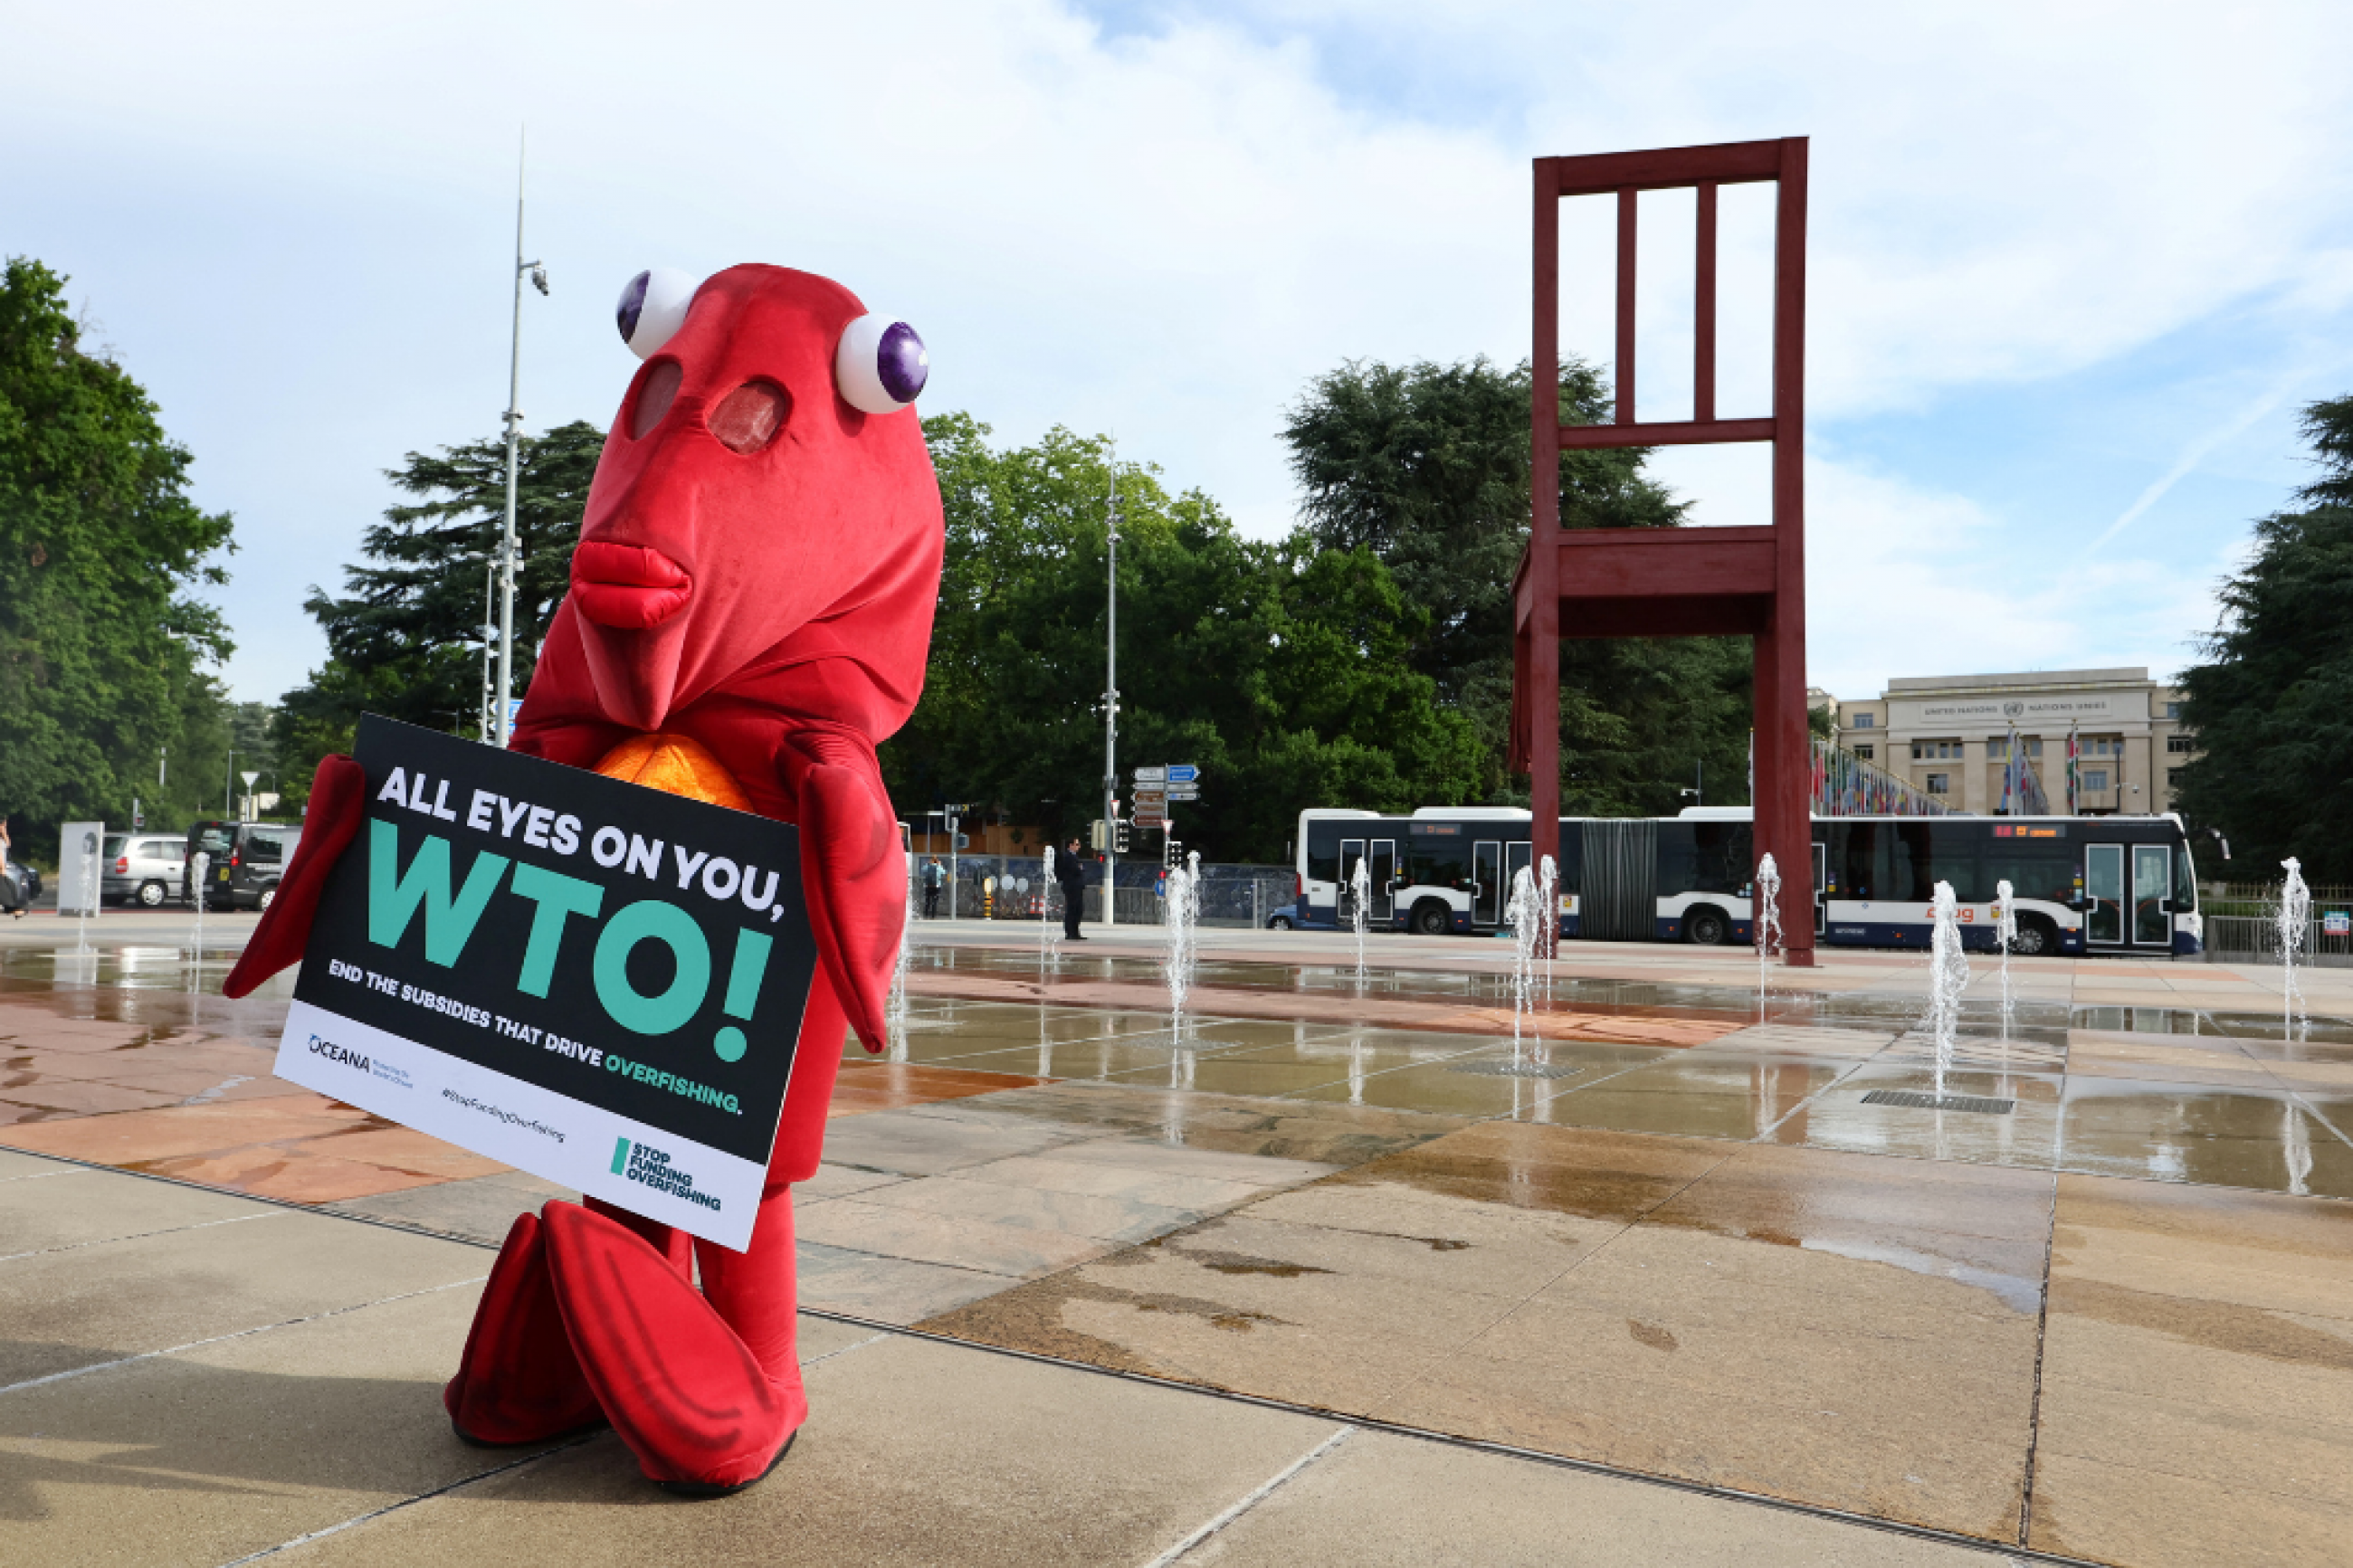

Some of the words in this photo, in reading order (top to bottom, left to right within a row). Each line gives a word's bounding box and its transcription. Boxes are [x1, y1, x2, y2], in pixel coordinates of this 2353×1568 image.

[1958, 705, 1997, 714] NATIONS
[2028, 701, 2073, 711] NATIONS
[377, 766, 456, 822] ALL
[466, 789, 583, 856] EYES
[591, 825, 663, 880] ON
[673, 844, 785, 922] YOU,
[368, 816, 774, 1062] WTO!
[308, 1033, 369, 1073] OCEANA
[329, 959, 362, 984] END
[366, 970, 400, 996] THE
[401, 983, 491, 1028] SUBSIDIES
[495, 1015, 543, 1045] THAT
[544, 1032, 604, 1067] DRIVE
[605, 1054, 743, 1116] OVERFISHING.
[441, 1088, 566, 1143] #StopFundingOverfishing
[629, 1154, 692, 1187] FUNDING
[634, 1142, 671, 1164] STOP
[626, 1168, 720, 1212] OVERFISHING
